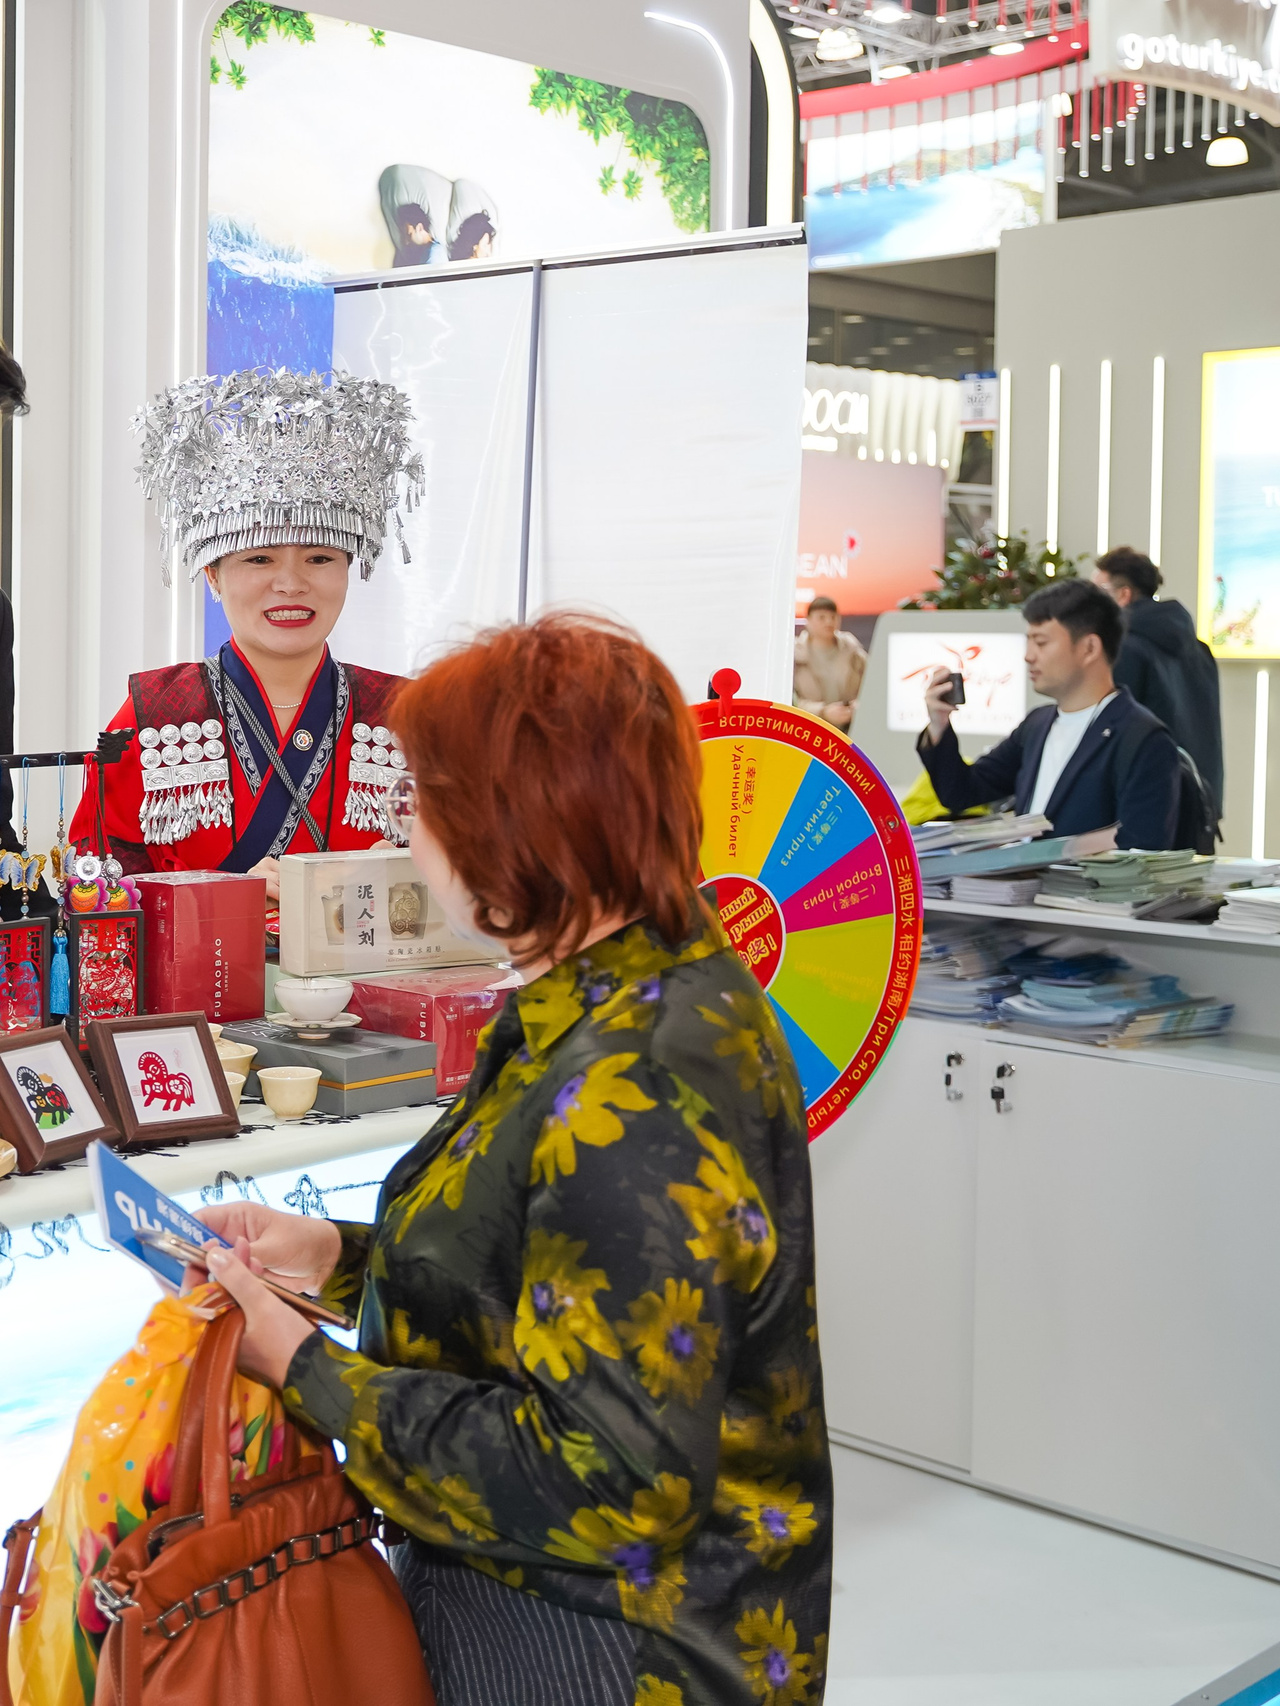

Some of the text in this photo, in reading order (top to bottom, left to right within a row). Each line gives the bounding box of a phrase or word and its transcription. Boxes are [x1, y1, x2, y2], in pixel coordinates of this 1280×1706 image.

[799, 552, 848, 579] EAN
[719, 714, 811, 742] встретимся
[812, 735, 823, 748] в
[823, 739, 876, 795] Хунани!
[729, 815, 740, 857] билет
[780, 785, 841, 866] Третий приз
[720, 886, 758, 922] ный
[803, 863, 883, 910] Второй приз
[894, 855, 915, 929] 三湘四水
[357, 884, 375, 947] 泥人刘
[728, 897, 774, 943] рыш!
[214, 938, 222, 1017] FUBAOBAO
[419, 1002, 427, 1039] FUBA
[466, 1028, 479, 1038] FU
[848, 1050, 876, 1080] Сяо,
[807, 1087, 850, 1128] четыр
